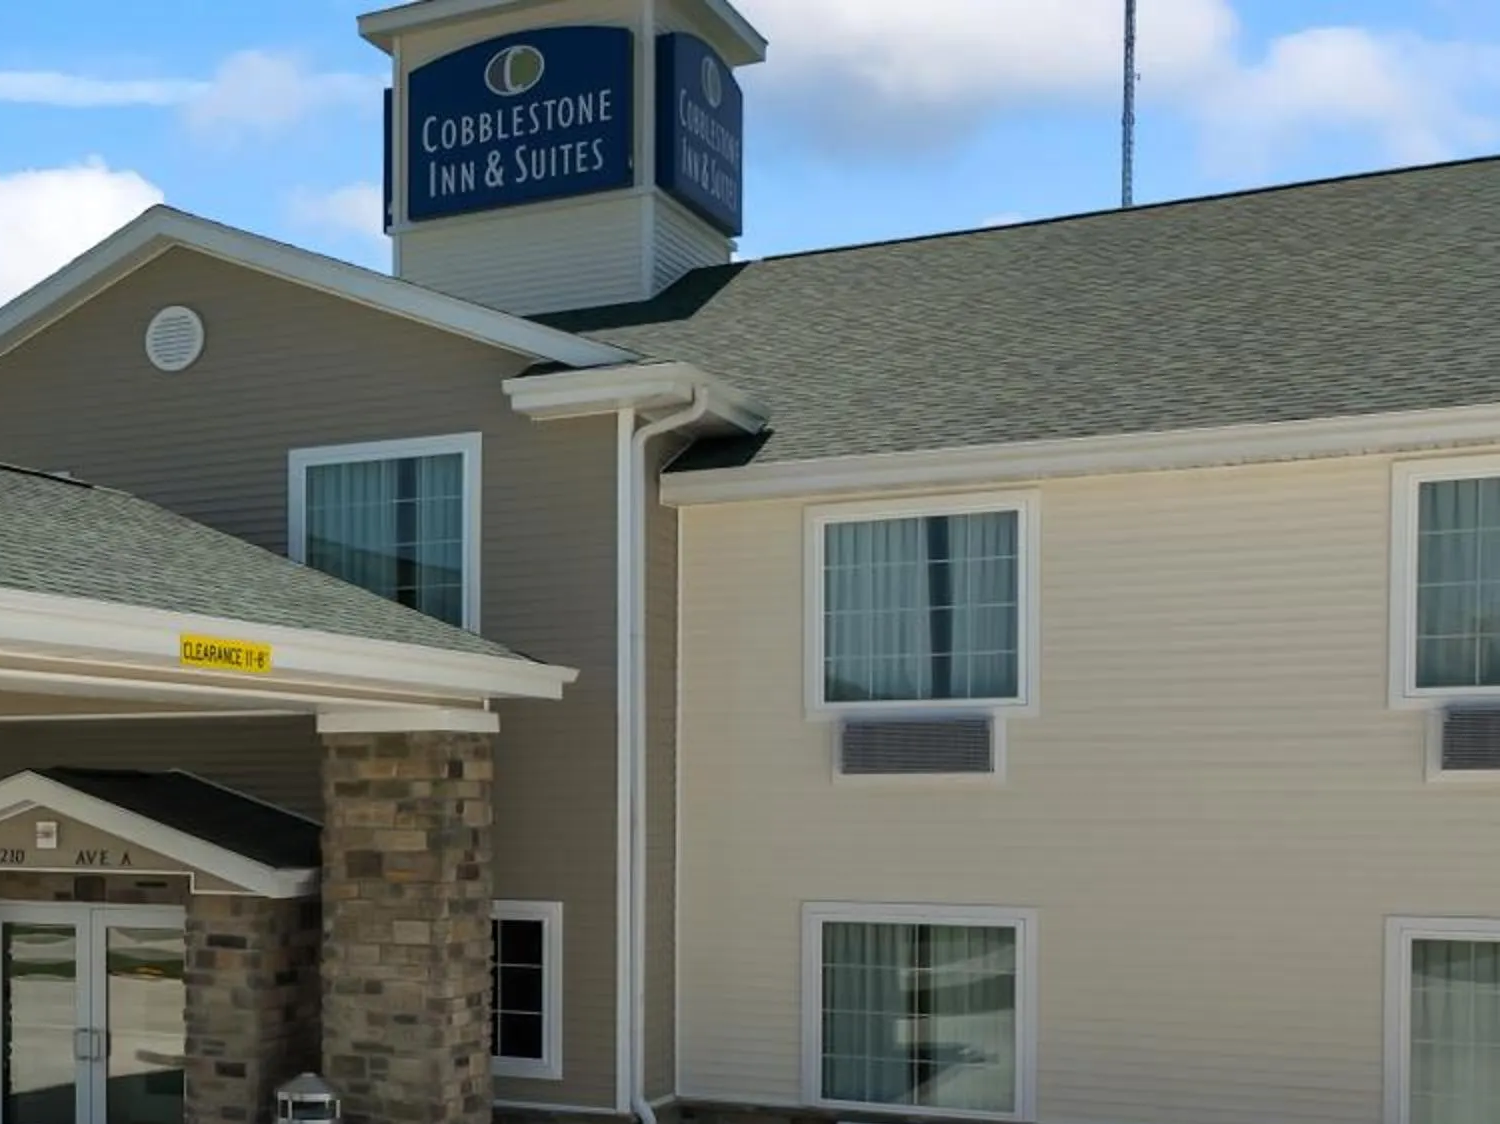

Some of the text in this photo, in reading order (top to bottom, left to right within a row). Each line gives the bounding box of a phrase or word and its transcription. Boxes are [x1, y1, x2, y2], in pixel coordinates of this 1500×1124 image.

[422, 89, 612, 153] COBBLESTONE
[429, 138, 604, 199] INN & SUITES
[183, 641, 242, 666] CLEARANCE
[75, 851, 110, 866] AVE
[120, 852, 132, 866] A
